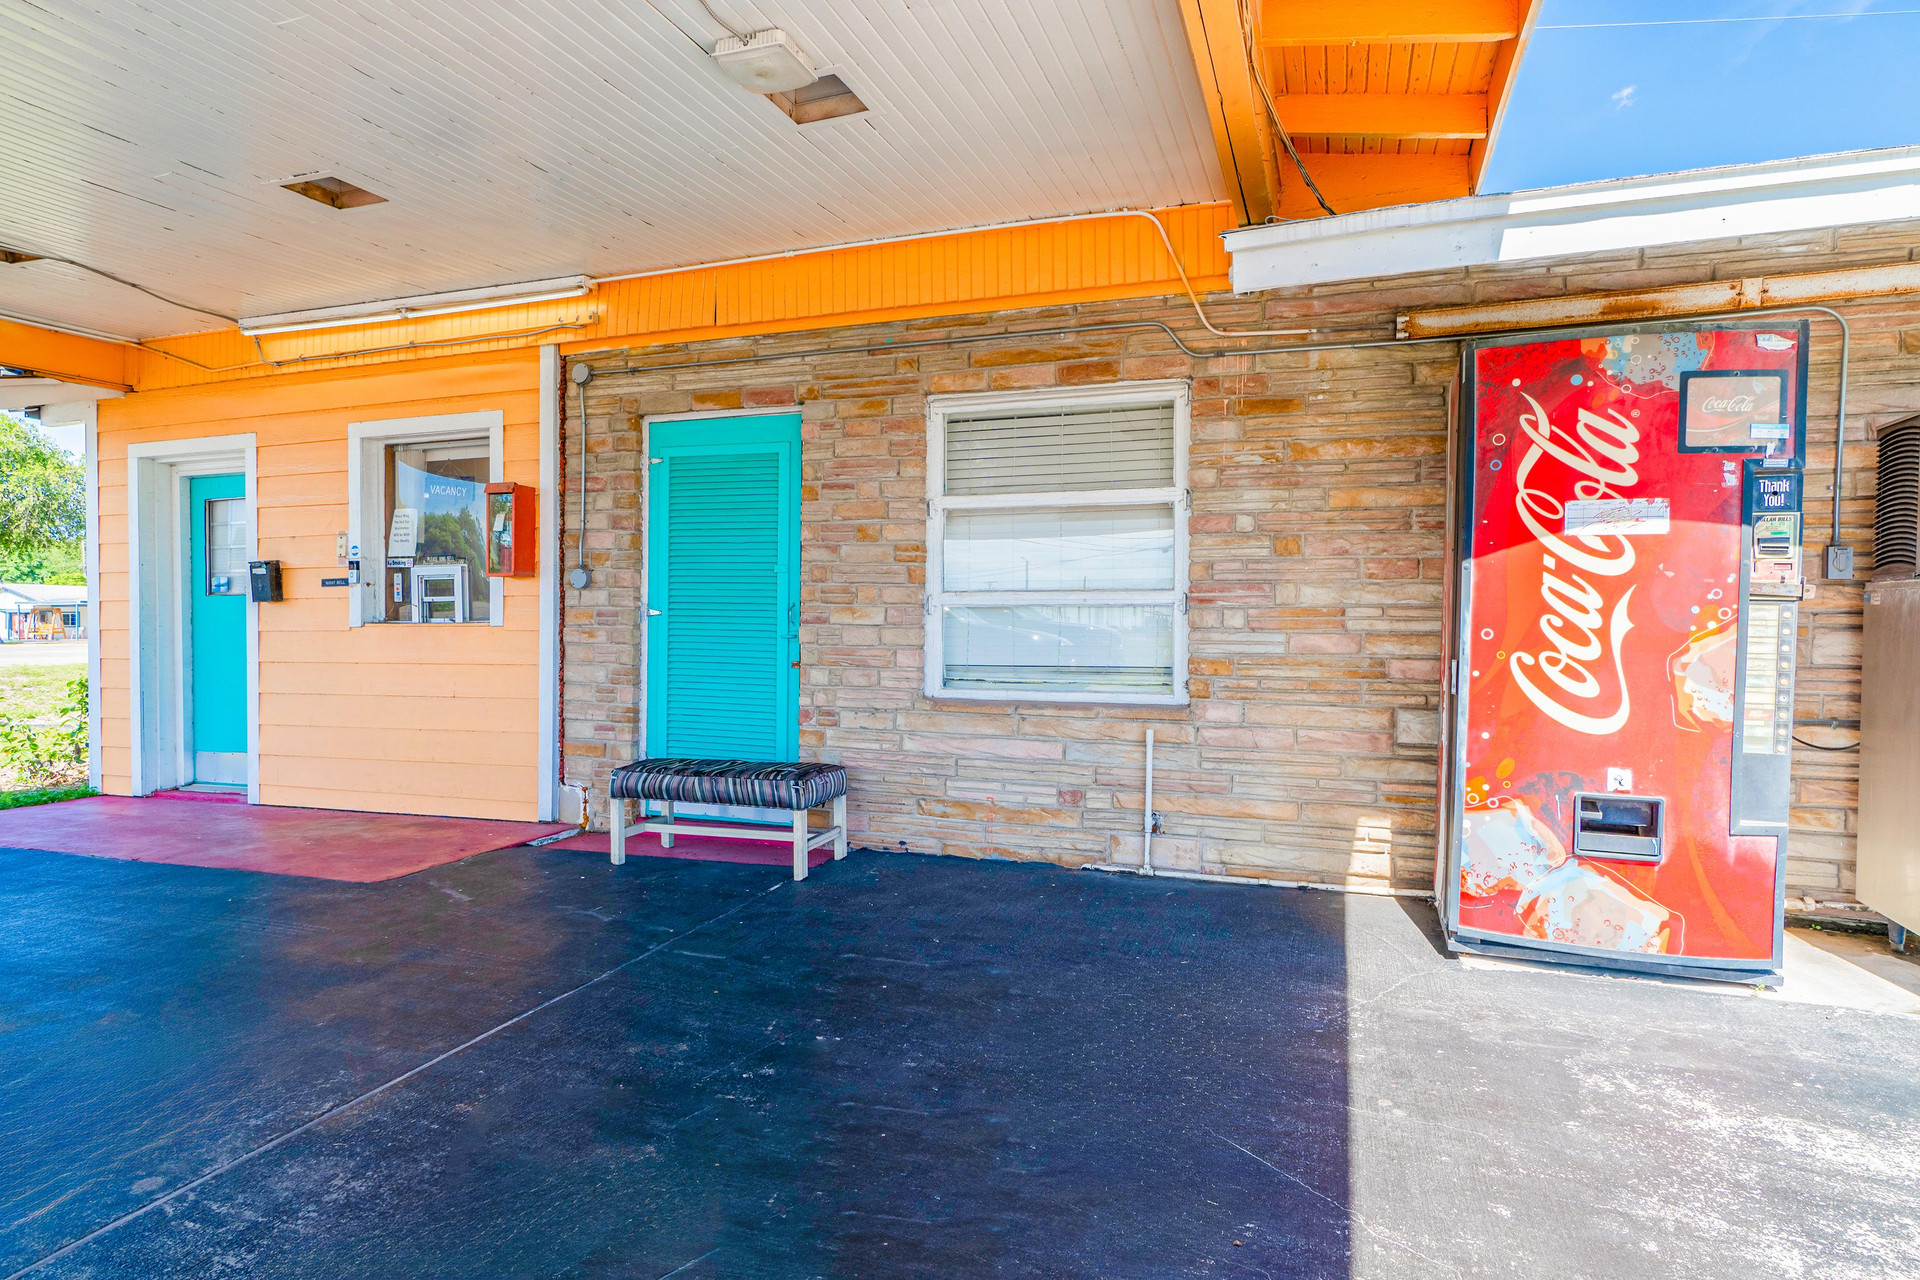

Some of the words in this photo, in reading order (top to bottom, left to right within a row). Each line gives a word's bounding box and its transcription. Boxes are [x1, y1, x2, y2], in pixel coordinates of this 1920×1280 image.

[1702, 395, 1758, 413] Coca-Cola
[430, 485, 467, 496] VACANCY
[1759, 479, 1790, 493] Thank
[1763, 494, 1785, 507] You!
[1509, 391, 1640, 735] Coca-Cola
